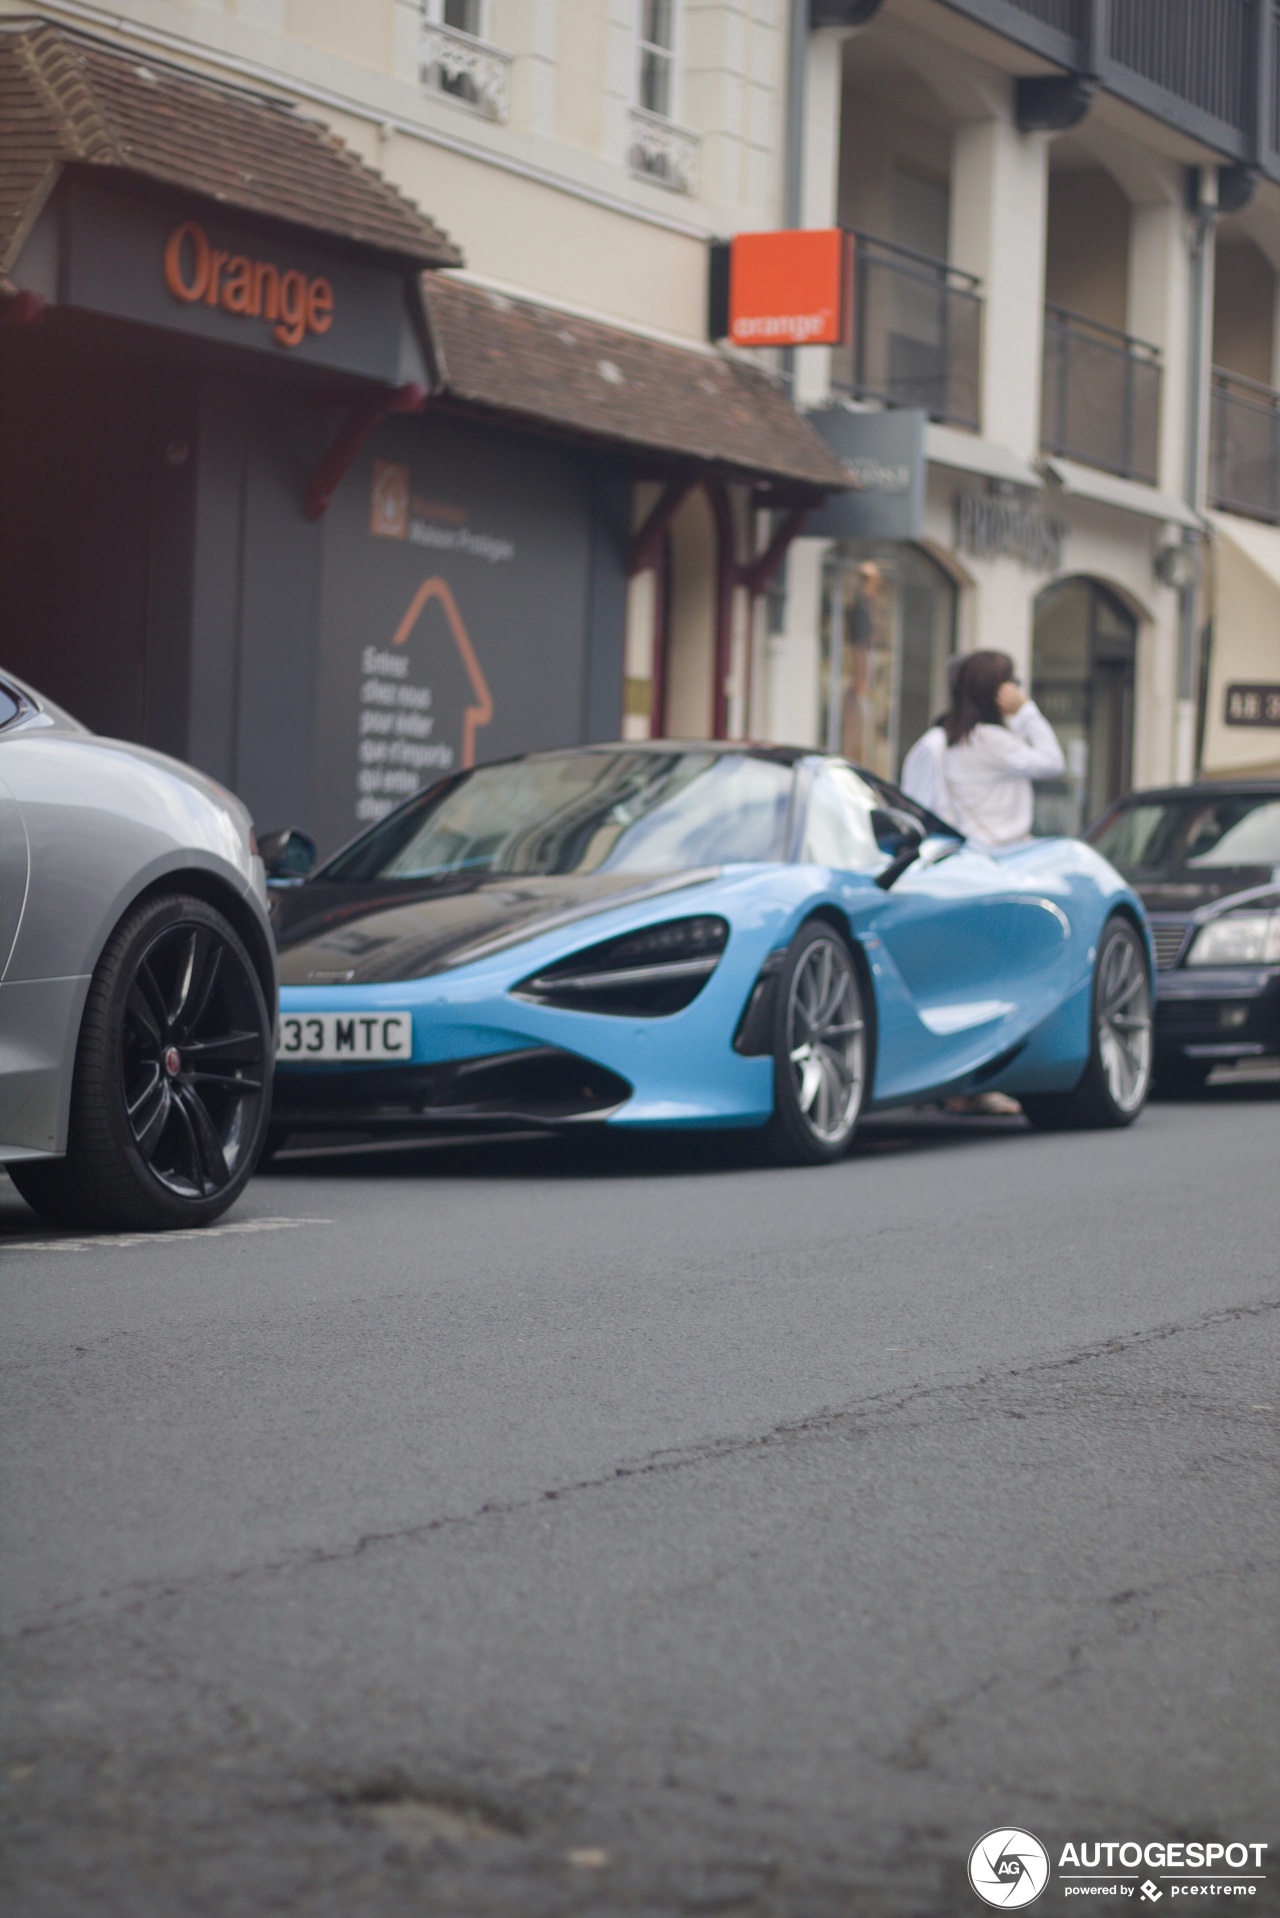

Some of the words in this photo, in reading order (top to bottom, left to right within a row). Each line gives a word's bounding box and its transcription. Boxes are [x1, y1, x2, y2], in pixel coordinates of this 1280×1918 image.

[165, 221, 334, 347] Orange
[733, 314, 826, 342] orange
[277, 1018, 325, 1053] 33
[335, 1018, 403, 1053] MTC
